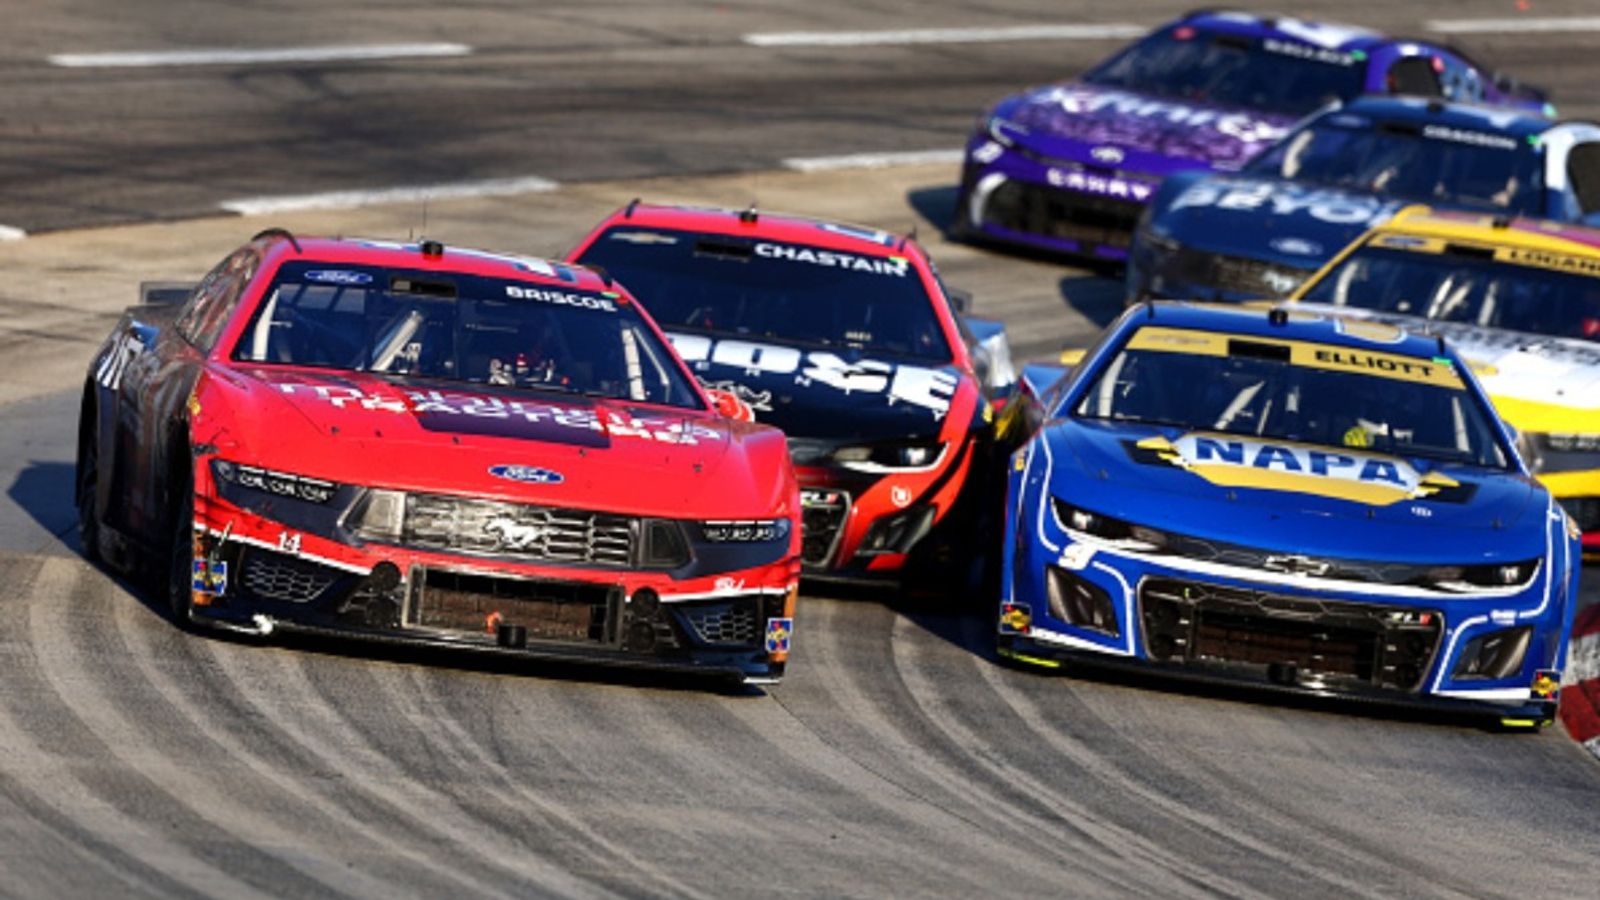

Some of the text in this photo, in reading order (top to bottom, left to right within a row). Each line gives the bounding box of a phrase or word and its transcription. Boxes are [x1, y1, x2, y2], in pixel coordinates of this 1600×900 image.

[754, 242, 907, 277] CHASTAIN
[505, 285, 617, 312] BRISCOE
[1314, 350, 1434, 377] ELLIOTT
[1195, 436, 1408, 487] NAPA
